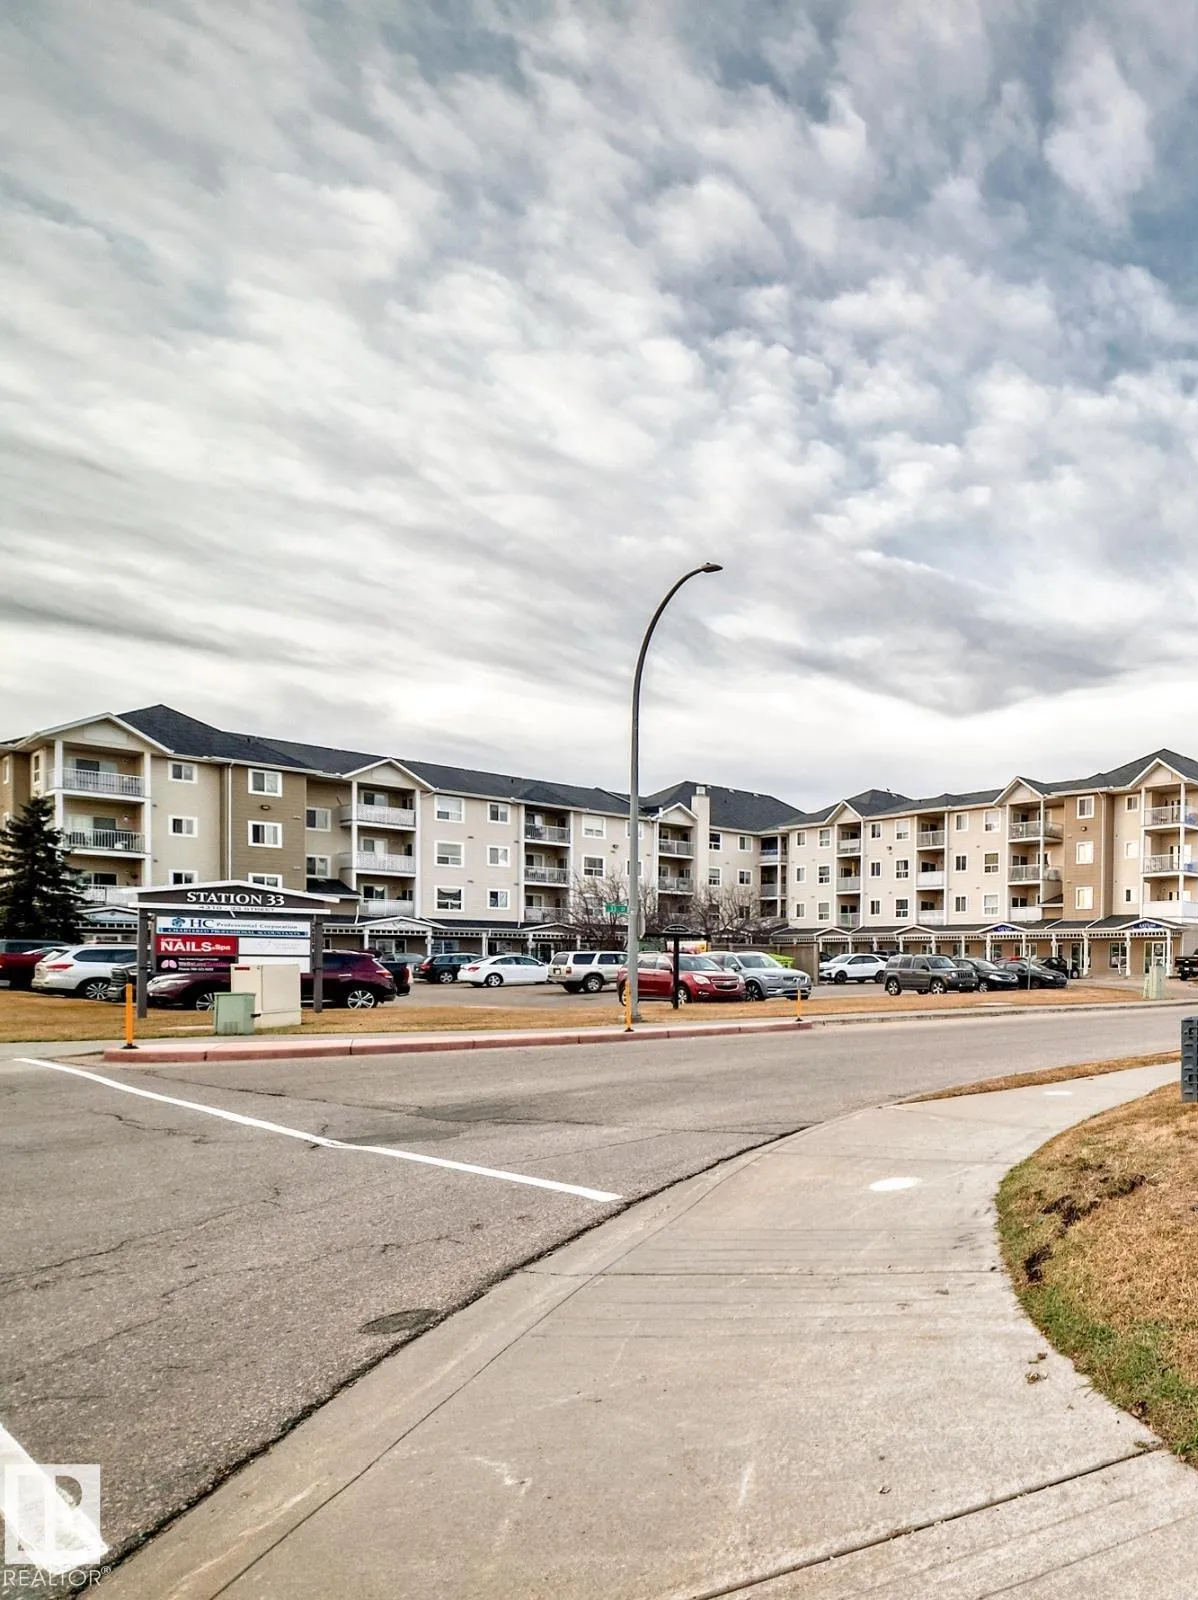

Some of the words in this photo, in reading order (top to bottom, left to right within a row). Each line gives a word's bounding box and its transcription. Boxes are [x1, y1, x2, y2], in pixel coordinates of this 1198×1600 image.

[186, 891, 262, 905] STATION
[266, 894, 285, 906] 33
[189, 918, 214, 928] HC
[160, 941, 212, 952] NAILS
